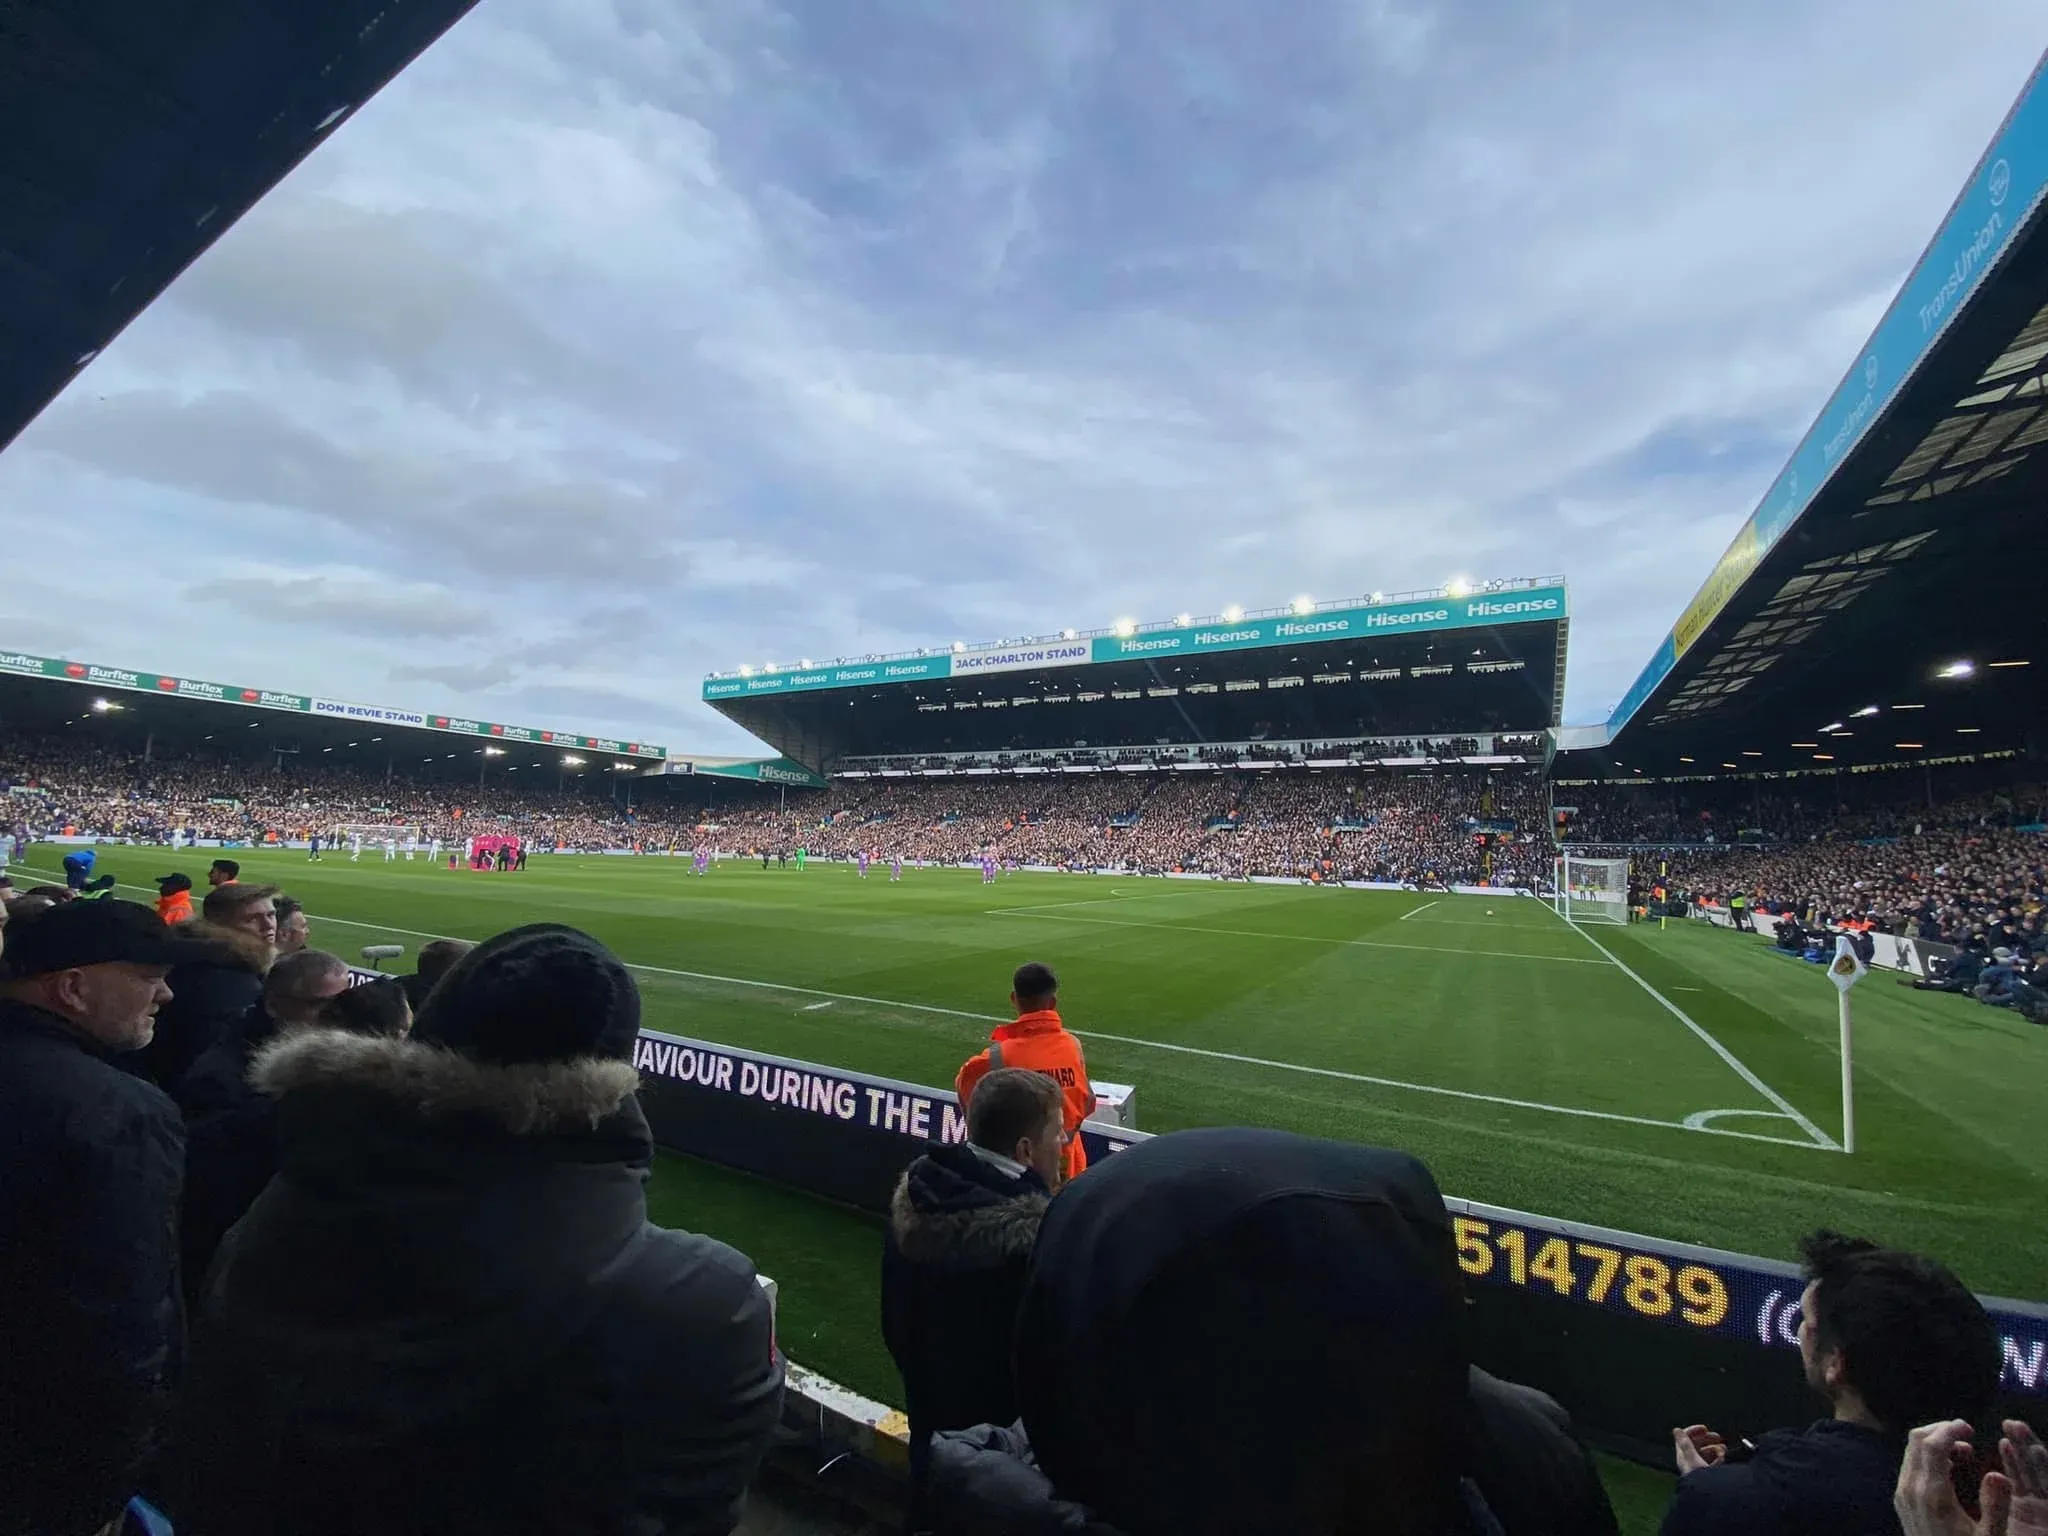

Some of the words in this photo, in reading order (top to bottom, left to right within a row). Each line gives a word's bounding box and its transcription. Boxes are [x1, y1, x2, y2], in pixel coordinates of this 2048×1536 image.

[1918, 211, 2003, 334] TransUnion
[1467, 598, 1558, 617] Hisense
[1366, 609, 1448, 628] Hisense
[1275, 619, 1349, 637] Hisense
[1121, 637, 1181, 653] Hisense
[1194, 629, 1261, 645] Hisense
[955, 658, 983, 669] JACK
[984, 652, 1044, 666] CHARLTON
[1046, 647, 1086, 660] STAND
[88, 666, 138, 682] Burflex
[836, 670, 876, 681] Hisense
[885, 665, 928, 676] Hisense
[179, 680, 224, 694] Burflex
[747, 679, 783, 690] Hisense
[790, 674, 828, 685] Hisense
[707, 684, 741, 694] Hisense
[261, 692, 302, 705] Burflex
[316, 702, 345, 713] DON
[347, 706, 382, 719] REVIE
[385, 711, 423, 723] STAND
[758, 764, 810, 782] Hisense
[739, 1061, 856, 1120] DURING
[865, 1088, 932, 1139] THE
[1453, 1217, 1728, 1327] 514789
